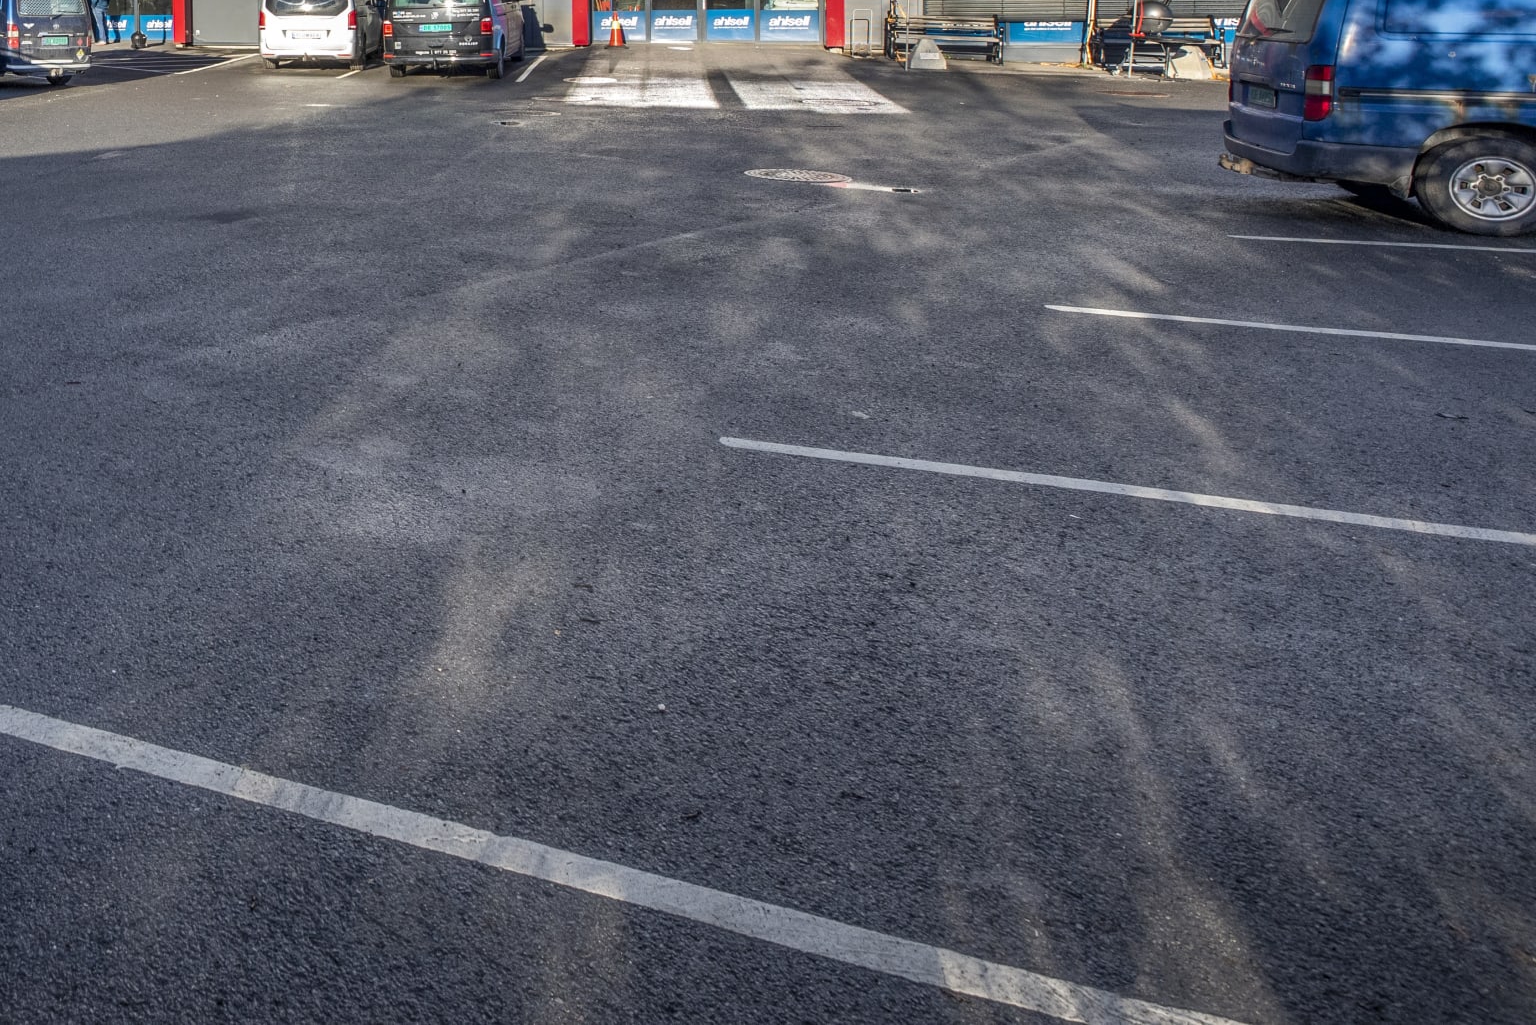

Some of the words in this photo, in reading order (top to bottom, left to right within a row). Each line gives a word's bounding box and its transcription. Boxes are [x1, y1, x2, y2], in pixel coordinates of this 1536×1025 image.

[146, 19, 173, 28] ahlsell
[600, 17, 638, 26] asell
[654, 16, 693, 26] ahlsell
[713, 16, 750, 26] ahlsell
[769, 16, 811, 27] ahlsell
